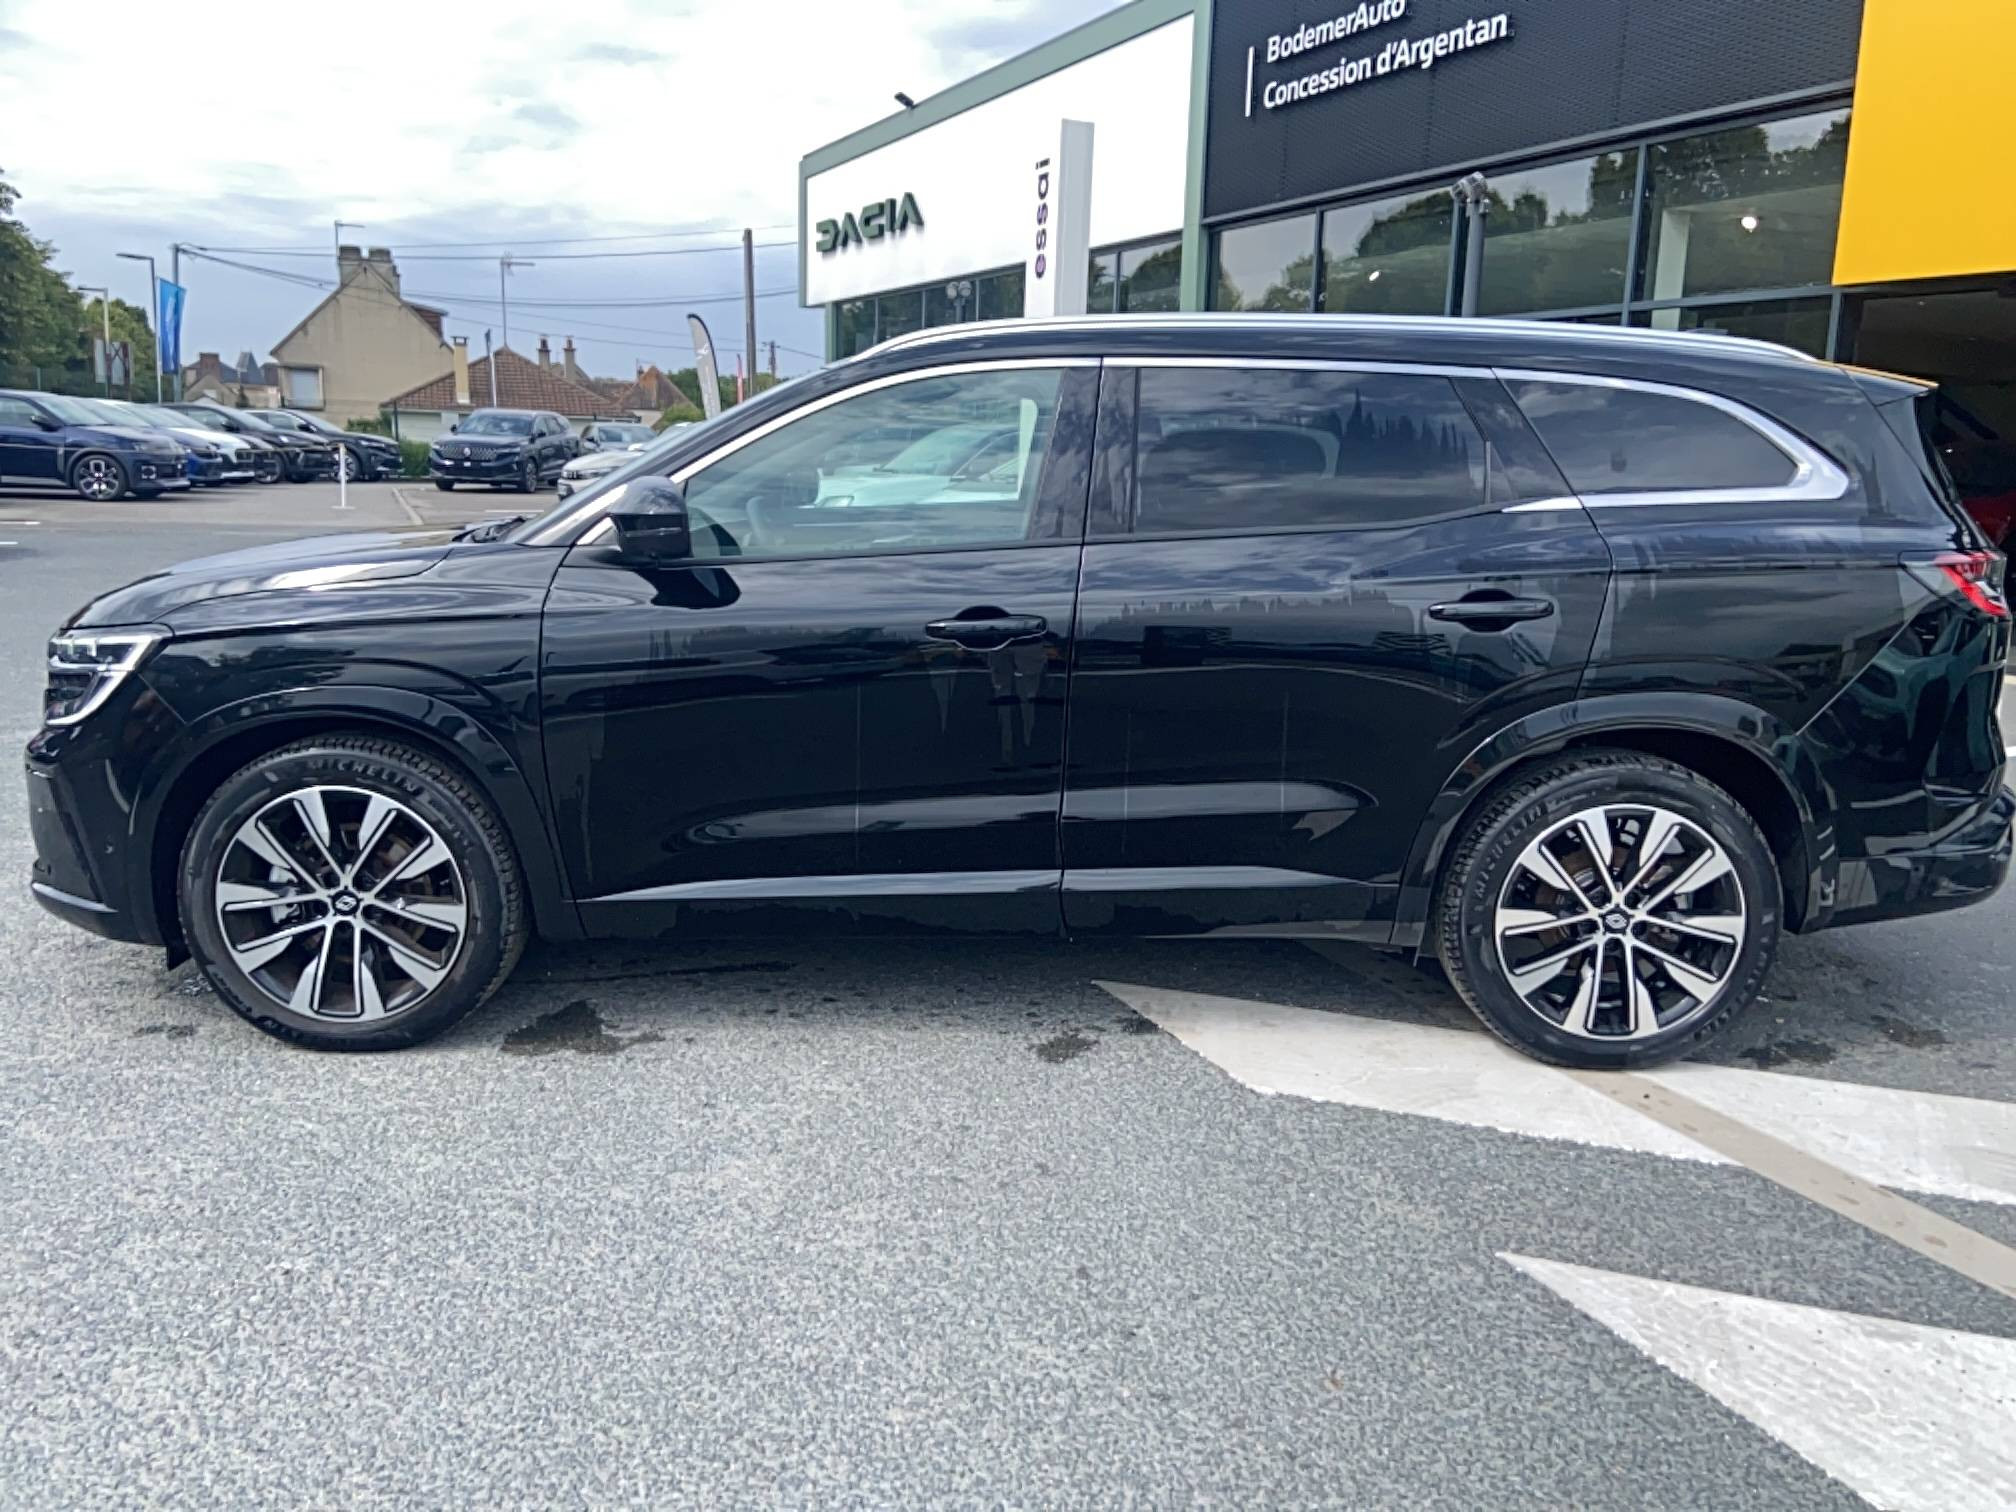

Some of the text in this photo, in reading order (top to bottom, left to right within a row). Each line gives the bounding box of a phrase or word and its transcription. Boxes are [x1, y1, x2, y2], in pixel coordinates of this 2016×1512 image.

[1263, 13, 1508, 109] Concession d'Argentan
[1266, 0, 1406, 63] BodemerAuto
[816, 192, 924, 254] DACIA
[1035, 158, 1050, 279] essai
